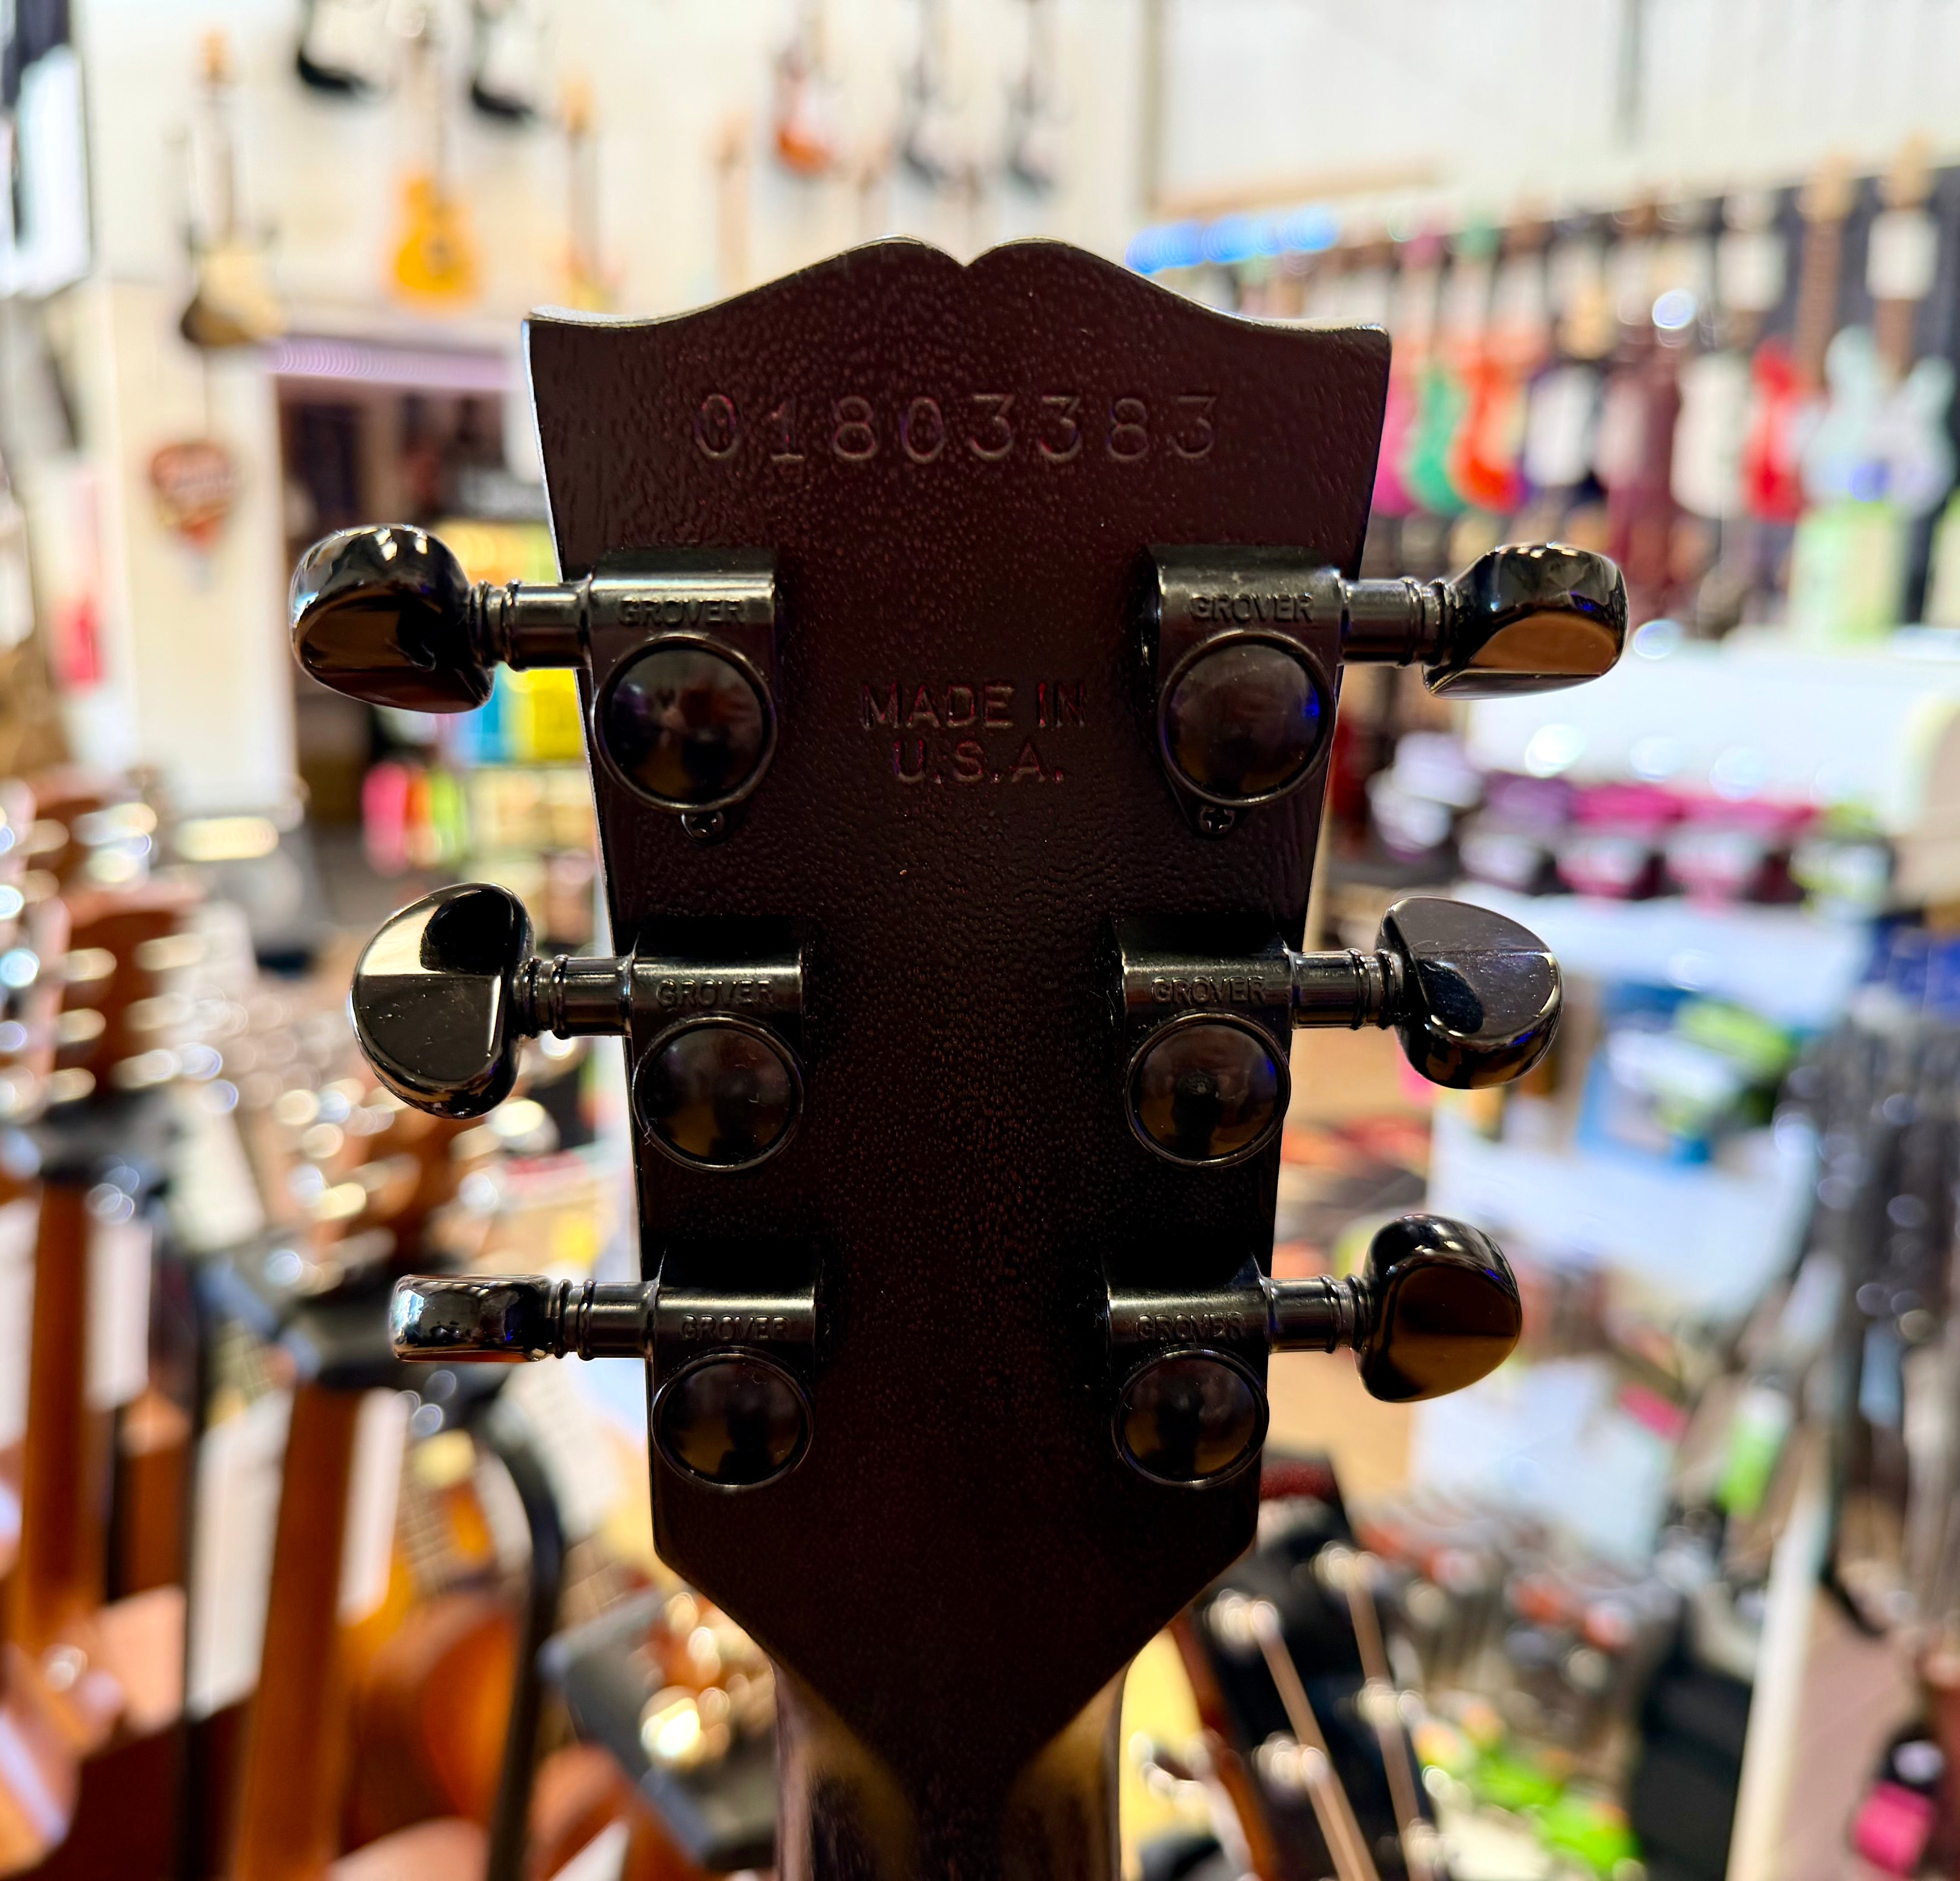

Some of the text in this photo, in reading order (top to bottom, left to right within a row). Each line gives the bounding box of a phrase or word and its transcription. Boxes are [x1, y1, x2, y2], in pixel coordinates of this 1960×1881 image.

[695, 393, 1218, 464] 01803383
[618, 597, 747, 627] GROVER
[1189, 593, 1314, 623] GROVER
[861, 681, 1087, 731] MADE IN
[893, 738, 1065, 784] U.S.A.
[657, 978, 775, 1008] GROVER
[1151, 976, 1266, 1005] GROVER
[681, 1315, 789, 1342] GROVER
[1136, 1312, 1245, 1342] GROVER
